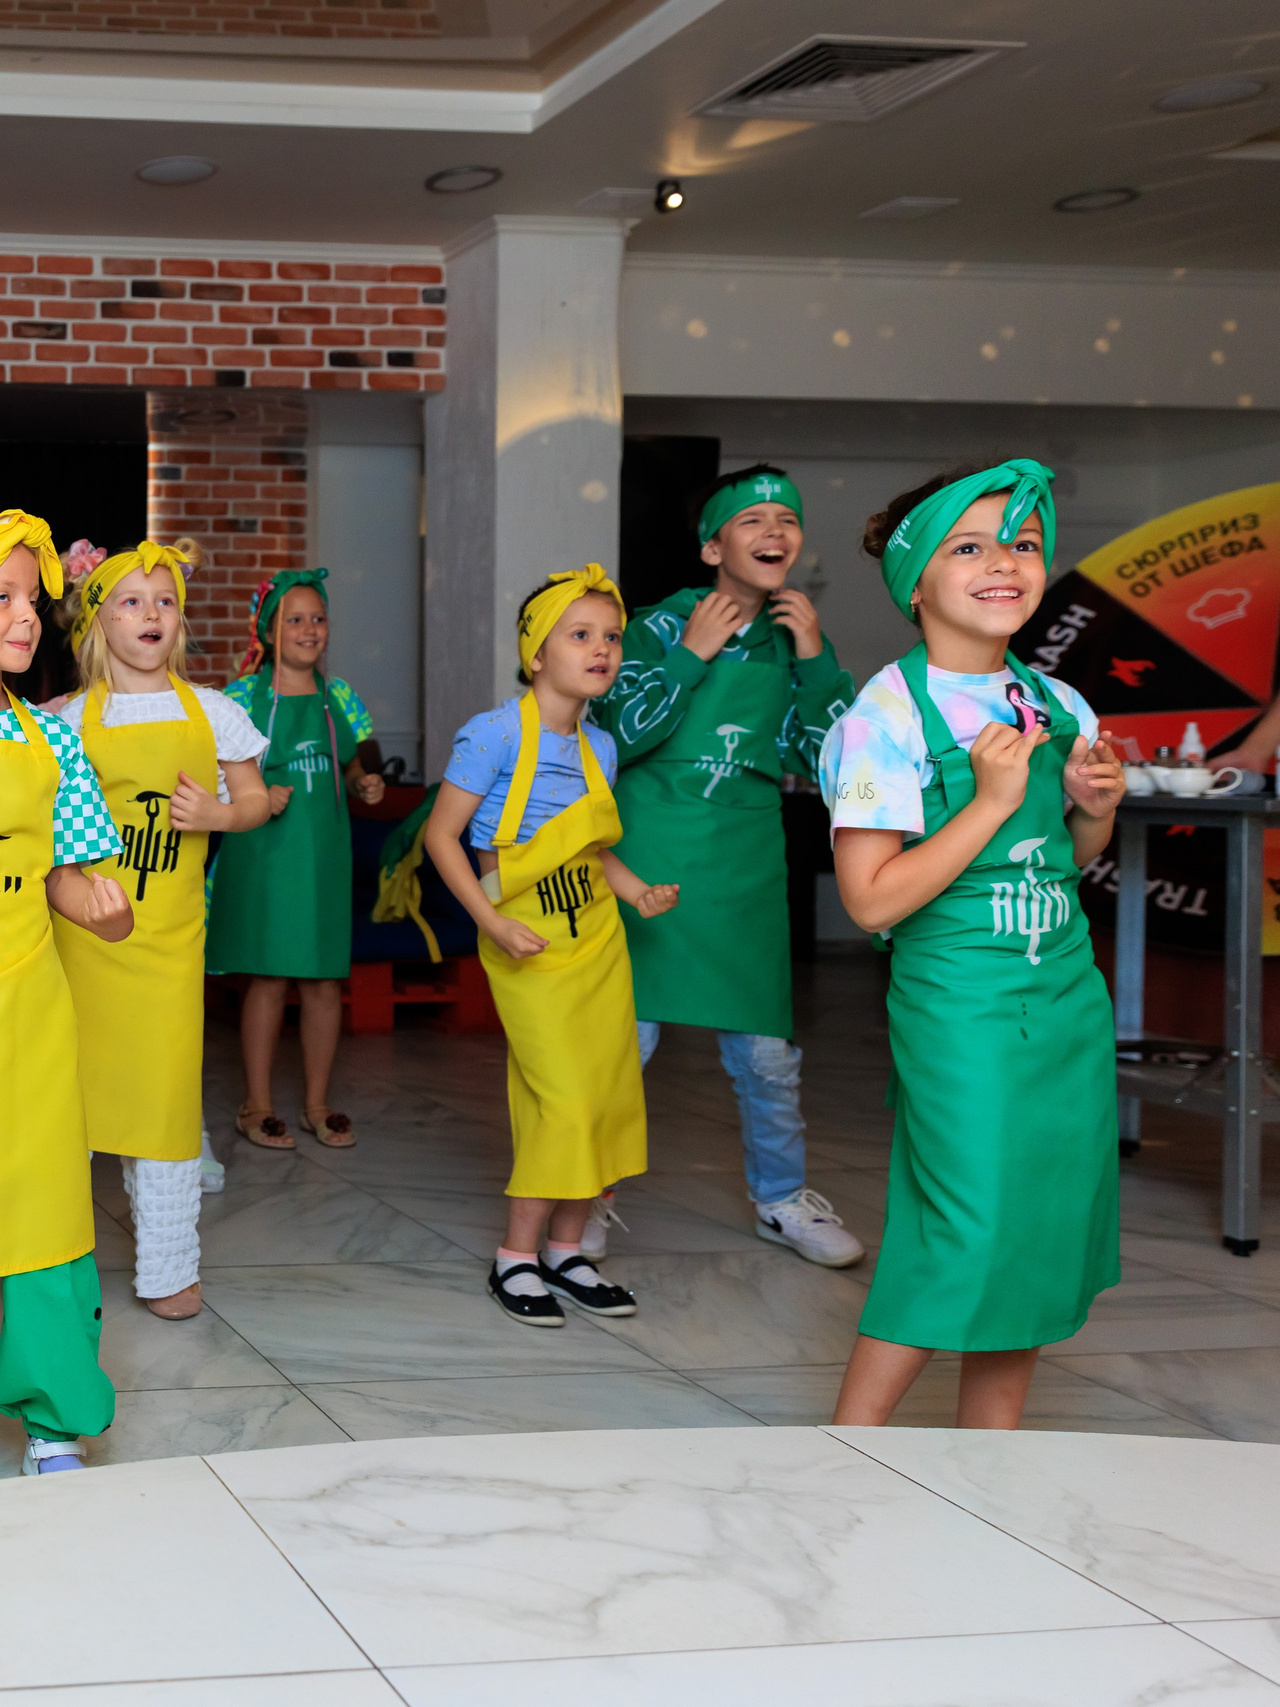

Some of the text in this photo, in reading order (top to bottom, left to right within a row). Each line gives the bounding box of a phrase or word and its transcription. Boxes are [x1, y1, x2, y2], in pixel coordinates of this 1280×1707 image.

[1116, 513, 1260, 581] СЮРПРИЗ
[1129, 536, 1267, 599] ОТ ШЕФА
[857, 782, 875, 800] US
